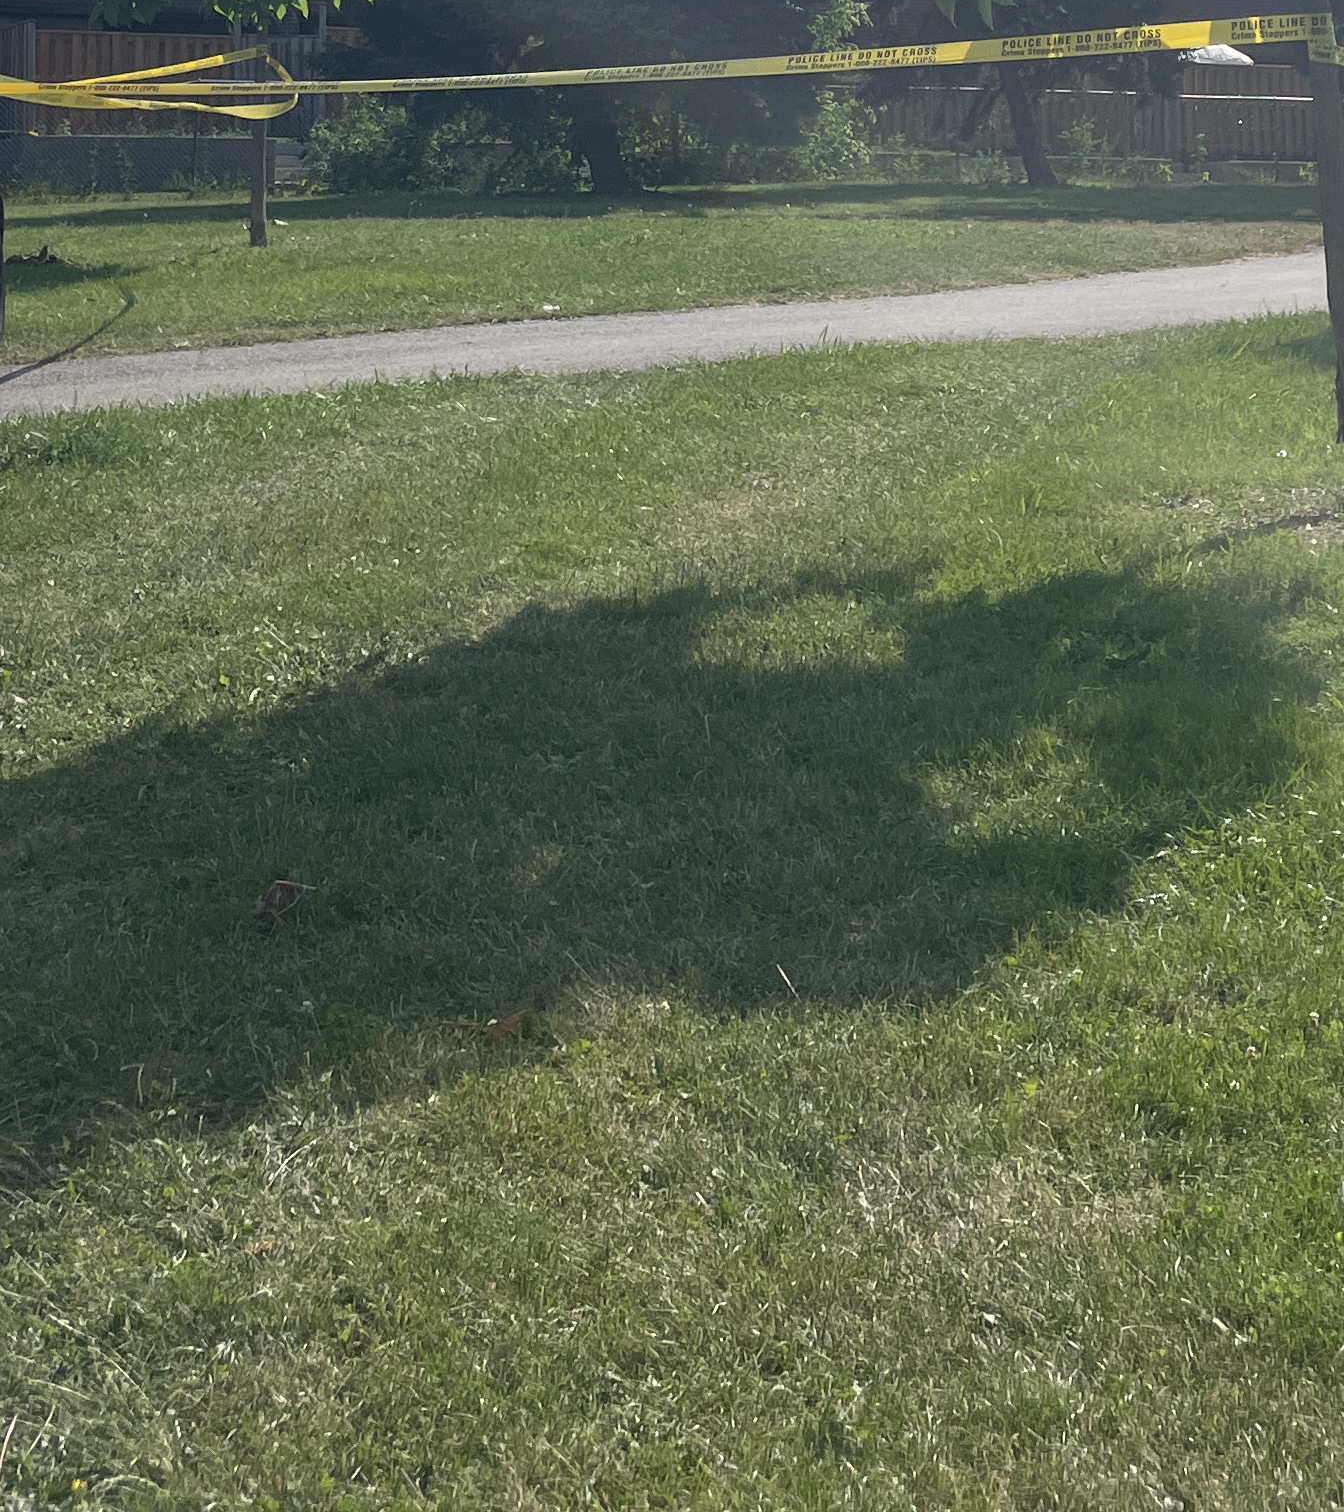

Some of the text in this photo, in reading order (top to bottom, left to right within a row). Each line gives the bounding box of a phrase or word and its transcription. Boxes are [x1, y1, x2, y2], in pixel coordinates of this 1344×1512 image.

[1231, 16, 1327, 31] POLICE LINE DO
[1002, 29, 1161, 49] POLICE LINE DO NOT CROSS
[788, 47, 937, 64] POLICE LINE DO NOT CROSS
